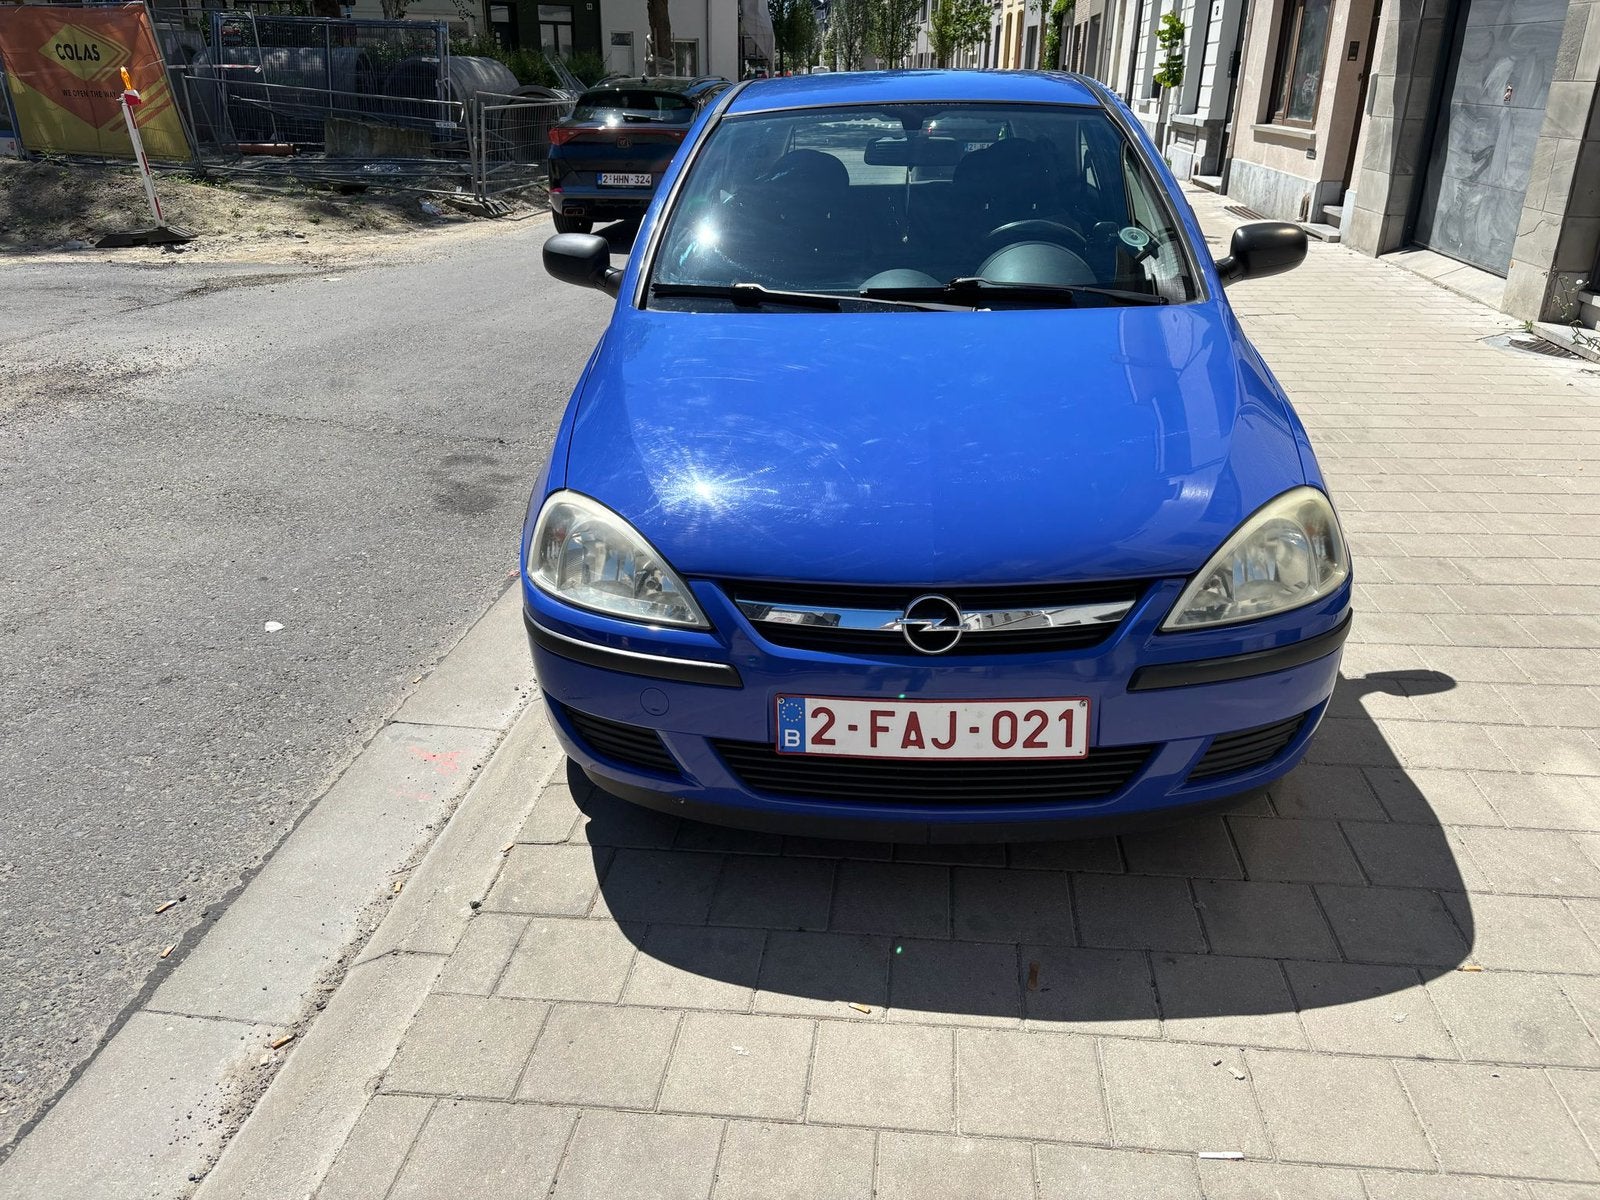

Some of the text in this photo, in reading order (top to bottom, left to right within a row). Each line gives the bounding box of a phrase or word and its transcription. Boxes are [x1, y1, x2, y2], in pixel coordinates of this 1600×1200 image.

[55, 43, 100, 61] COLAS
[63, 89, 116, 98] WE OPEN THE WAY
[602, 174, 651, 185] 2-HHN-324
[784, 706, 1074, 750] B 2-FAJ-021
